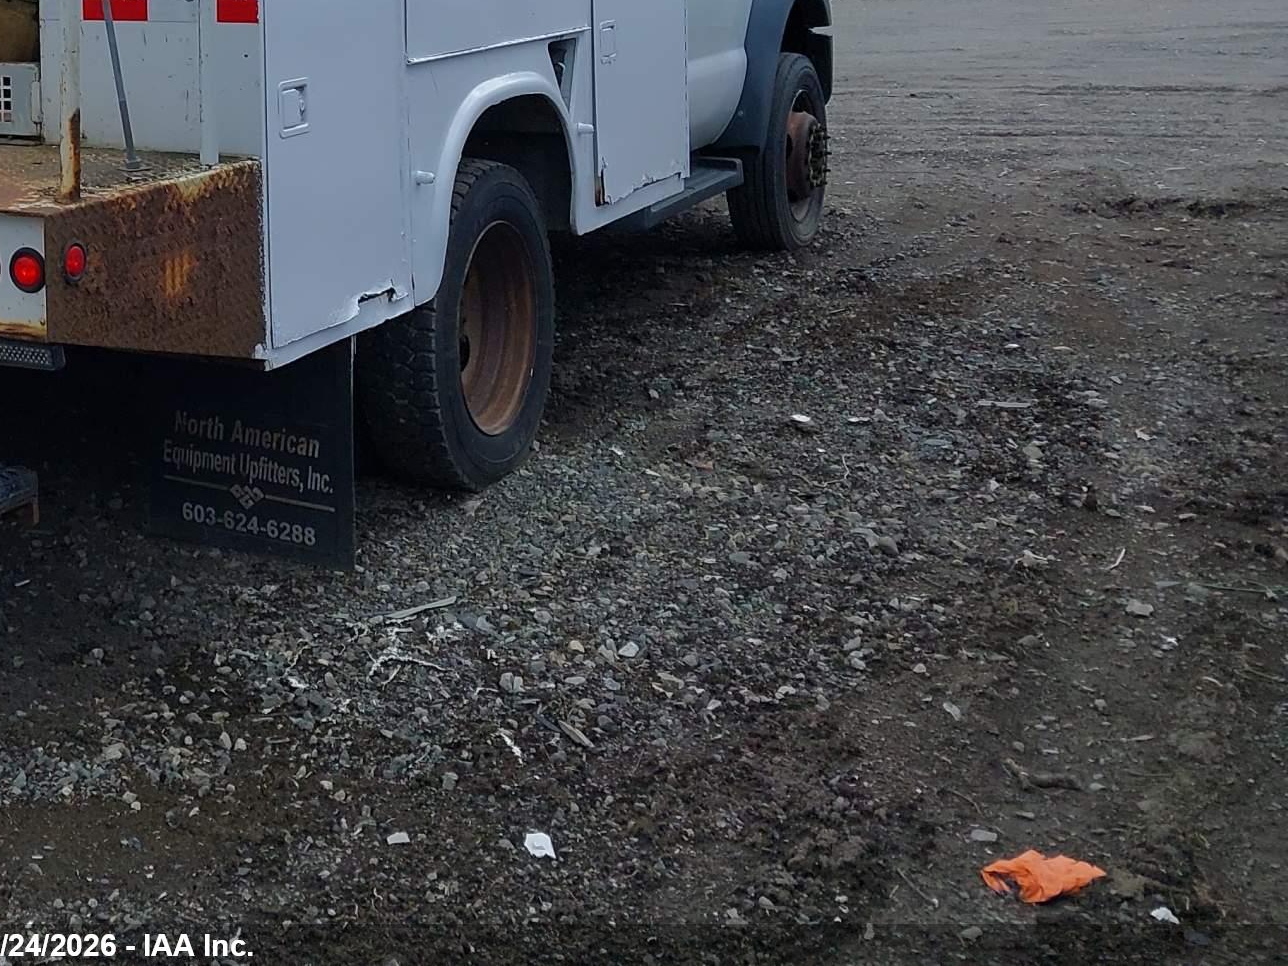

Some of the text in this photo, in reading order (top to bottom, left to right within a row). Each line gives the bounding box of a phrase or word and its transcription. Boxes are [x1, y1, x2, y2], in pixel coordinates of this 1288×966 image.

[174, 409, 320, 459] North American
[163, 439, 334, 494] Equipment Upfitters, Inc.
[182, 501, 317, 546] 603-624-6288
